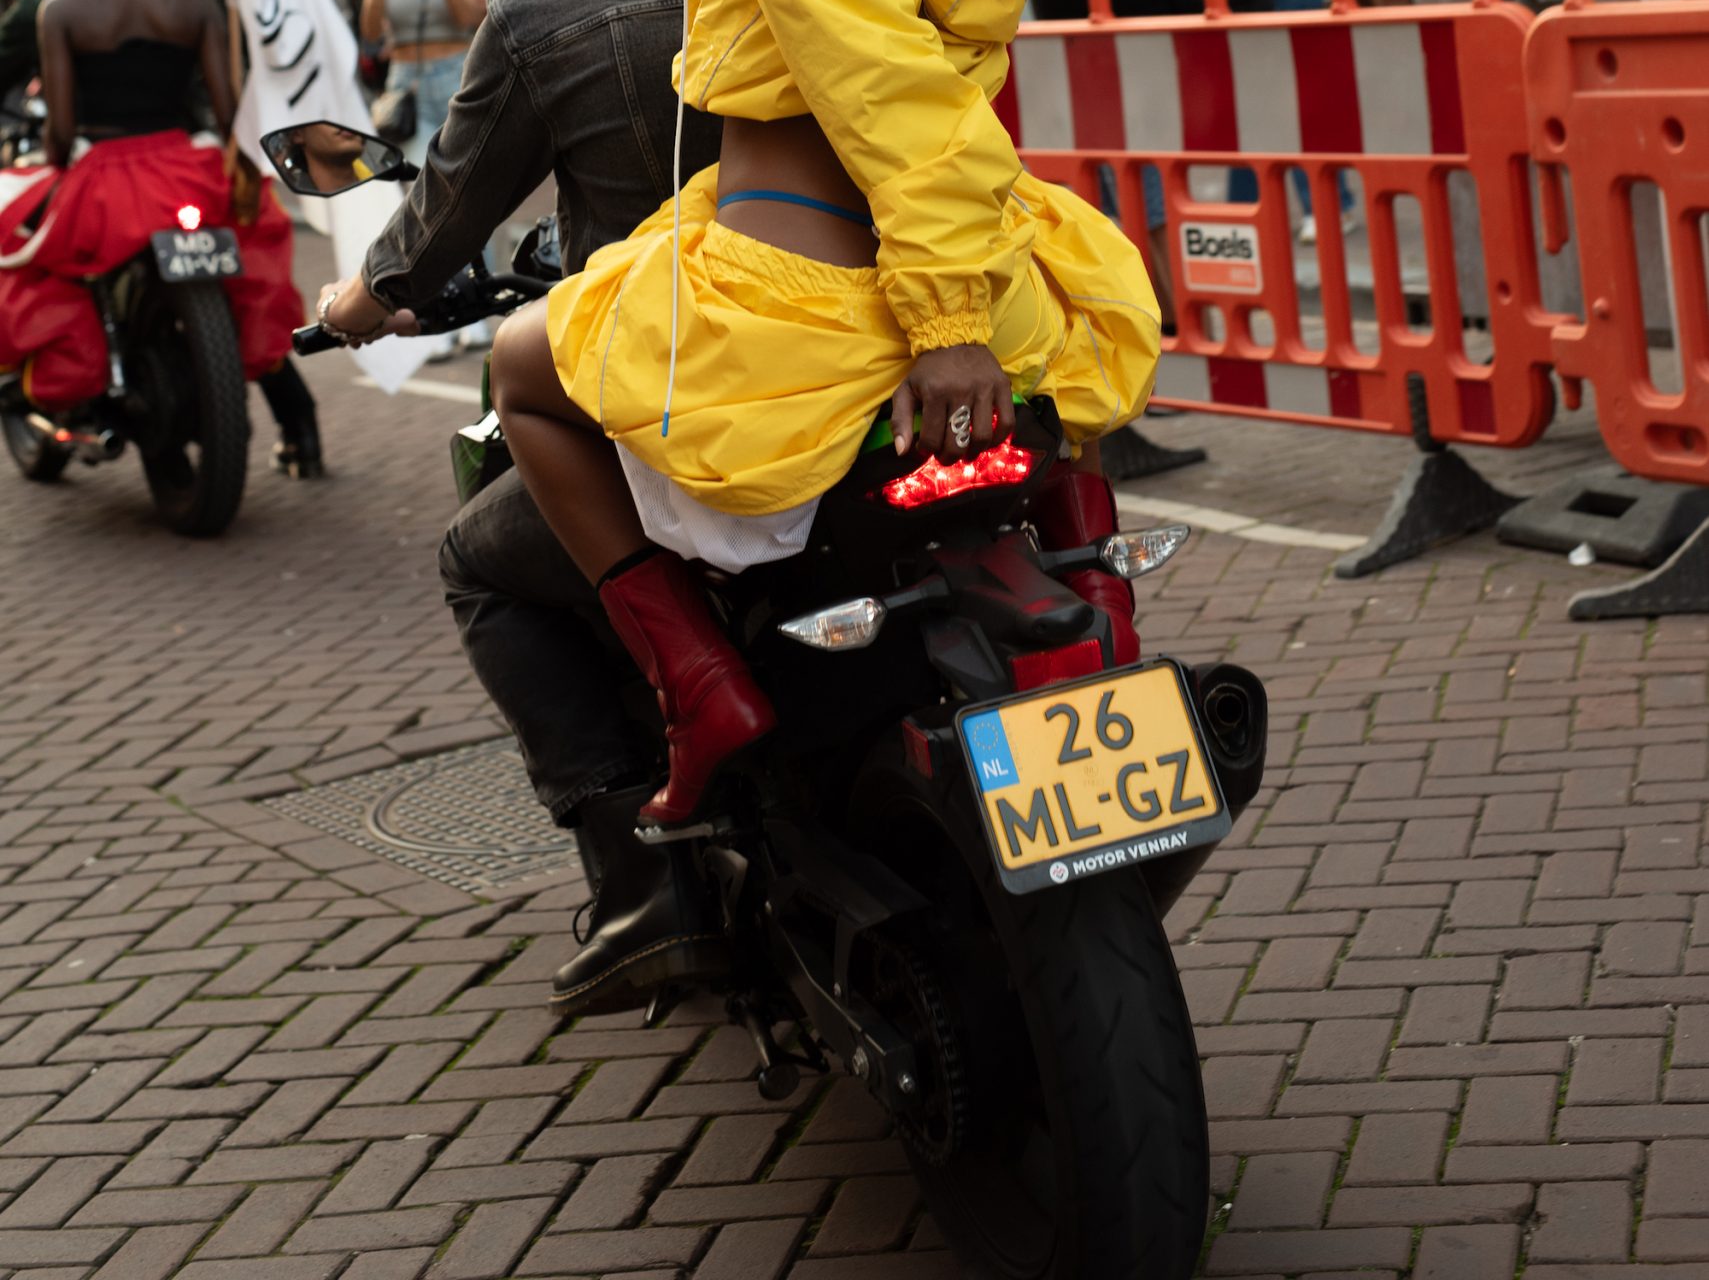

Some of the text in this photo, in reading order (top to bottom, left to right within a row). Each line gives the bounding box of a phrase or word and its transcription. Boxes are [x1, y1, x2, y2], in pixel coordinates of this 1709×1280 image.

[1186, 227, 1253, 260] Boels
[1044, 689, 1134, 766] 26
[982, 758, 1009, 780] NL
[996, 749, 1205, 858] ML-GZ
[1072, 831, 1188, 875] MOTOR VENRAY
